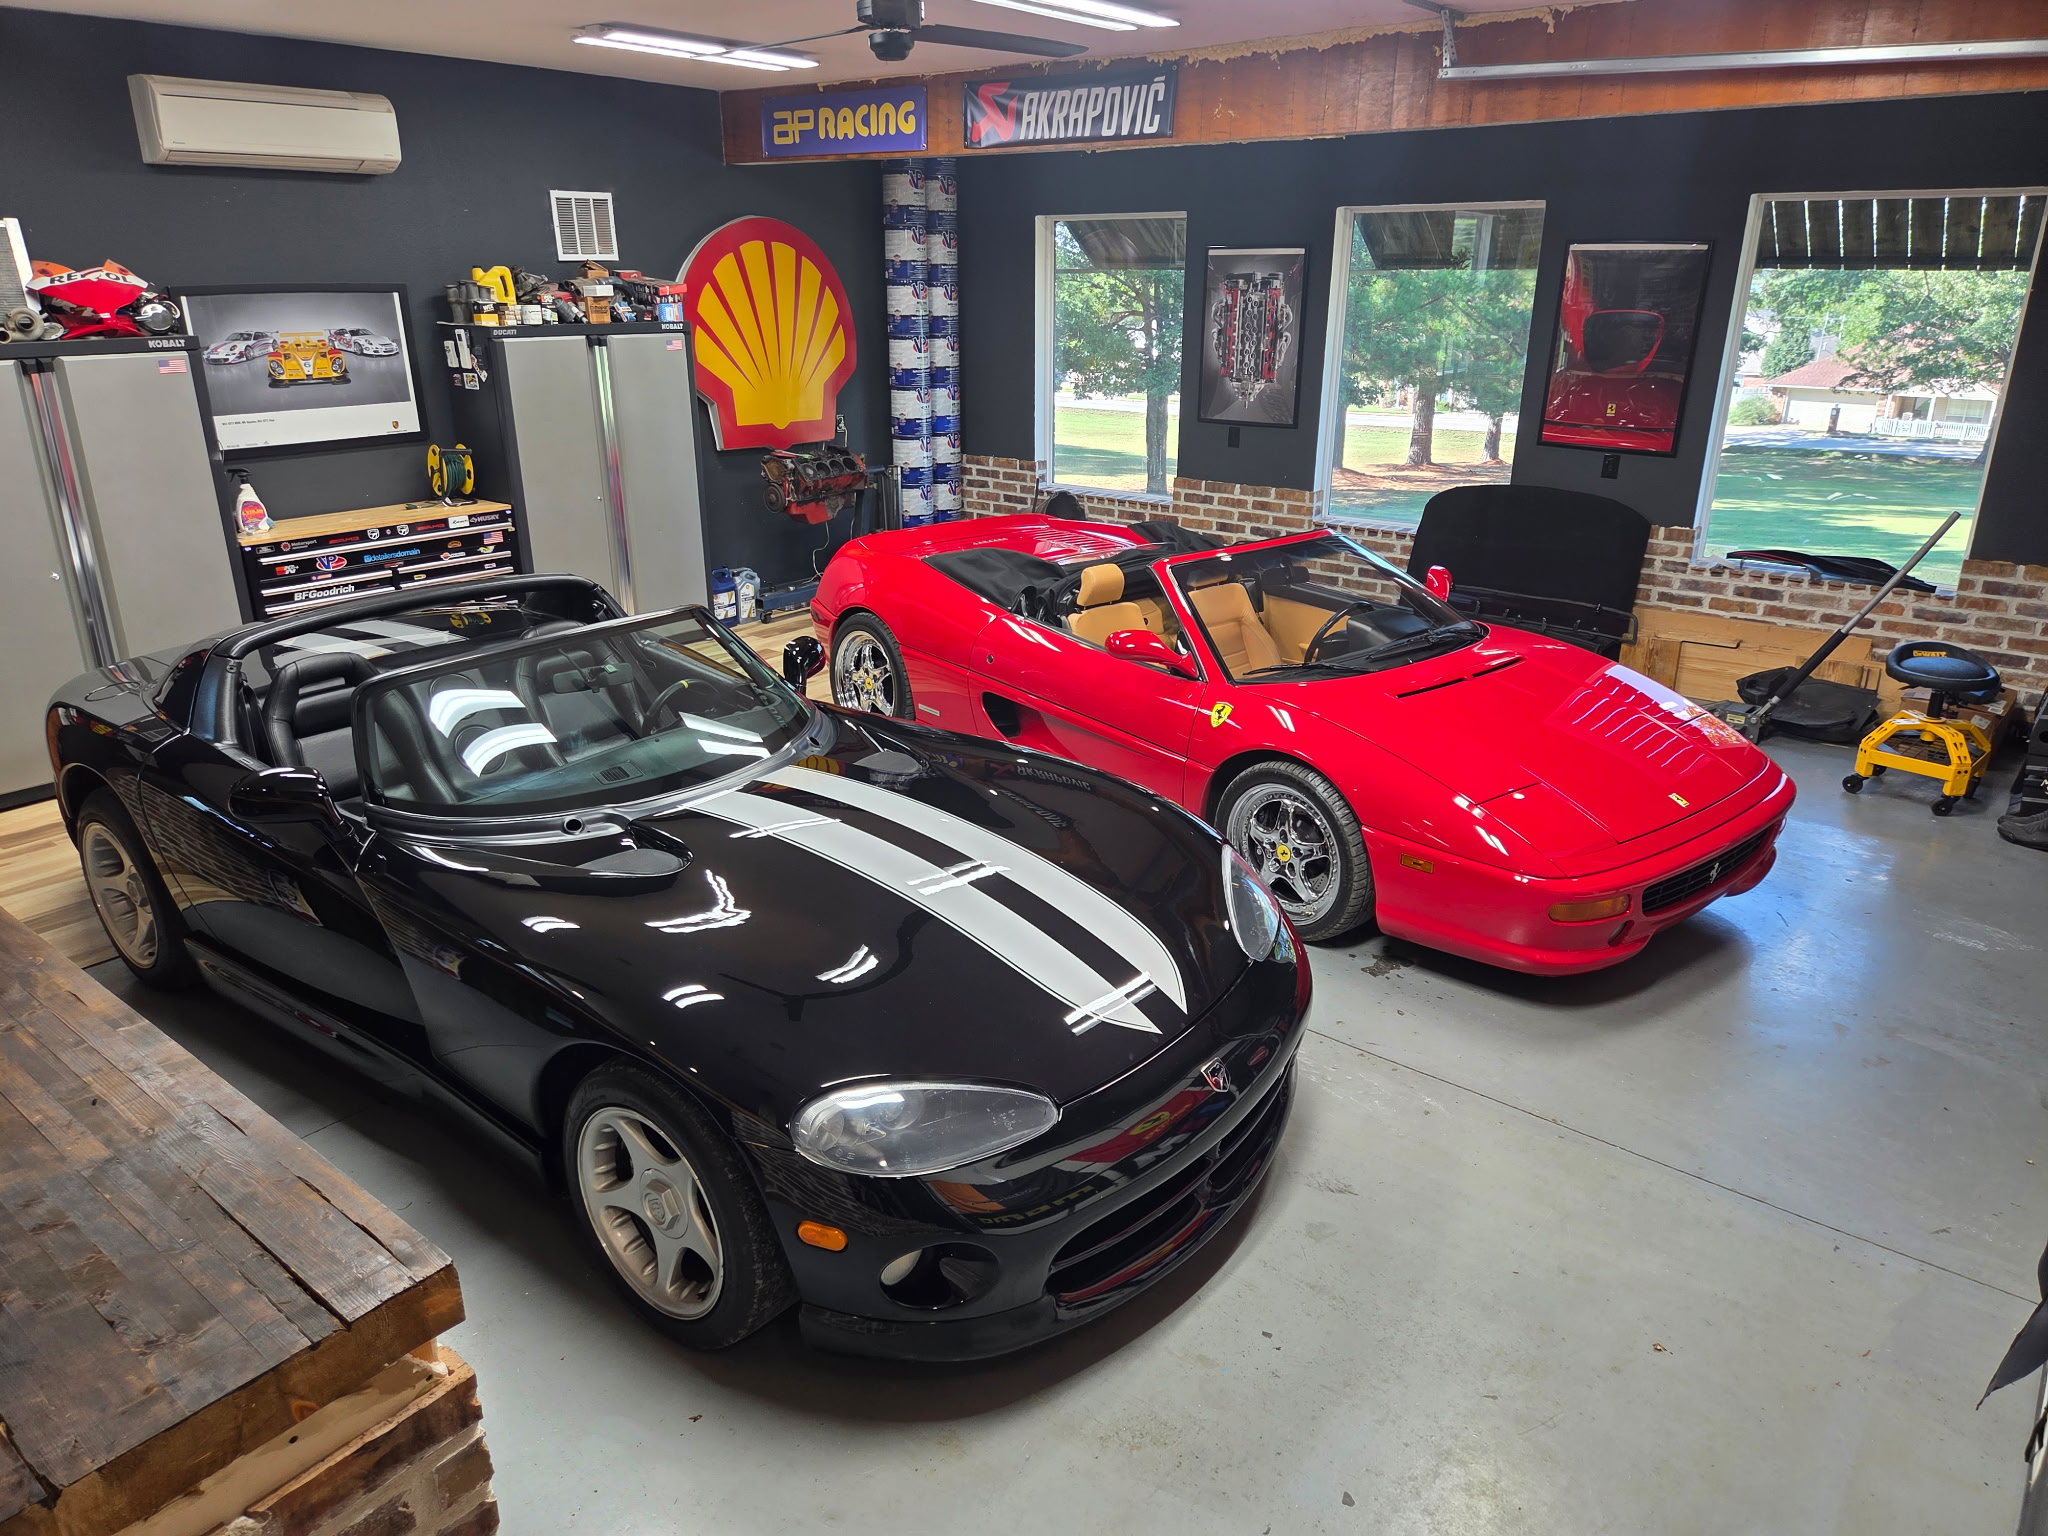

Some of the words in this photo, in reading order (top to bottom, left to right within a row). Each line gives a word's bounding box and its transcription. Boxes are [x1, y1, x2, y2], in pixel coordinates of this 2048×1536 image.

[1019, 75, 1166, 140] AKRAPOVIĆ
[818, 100, 916, 140] RACING
[148, 339, 186, 348] KOBALT
[477, 514, 500, 523] HUSKY
[294, 585, 355, 601] BFGoodrich
